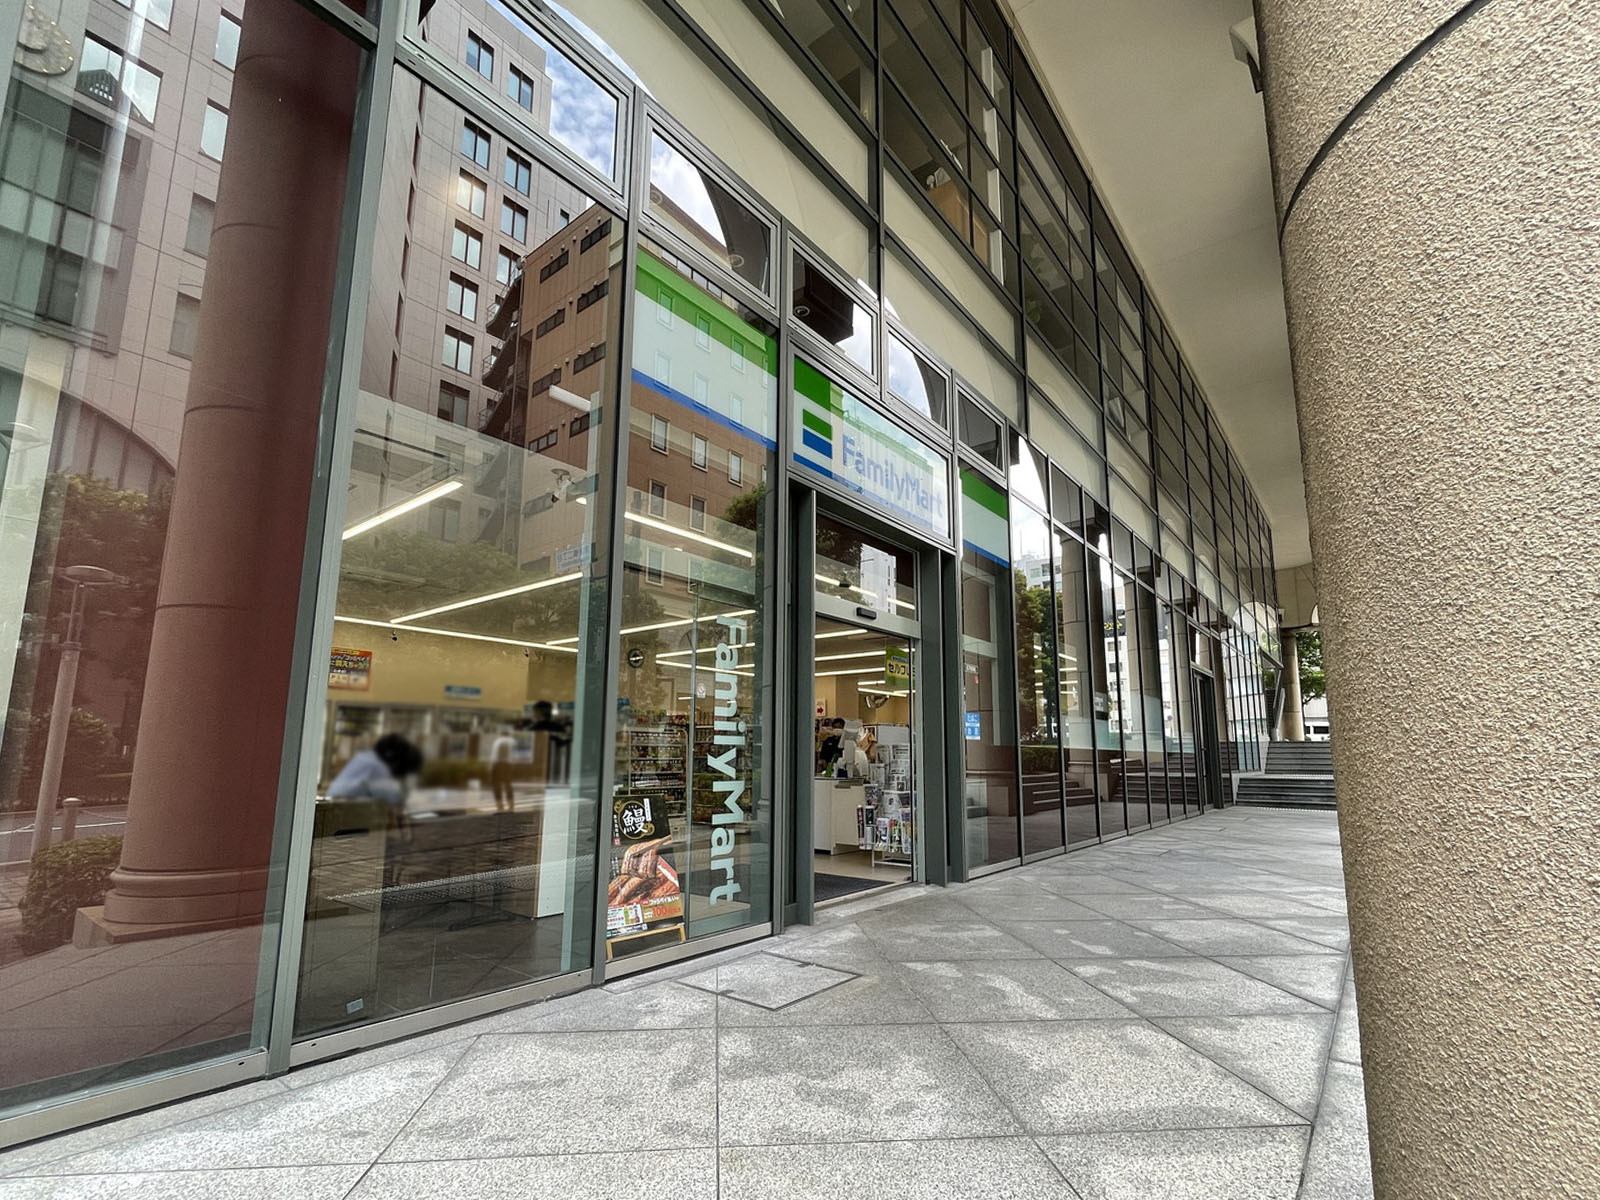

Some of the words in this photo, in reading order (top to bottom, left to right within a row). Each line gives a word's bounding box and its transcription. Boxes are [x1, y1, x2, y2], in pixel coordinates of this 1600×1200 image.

[842, 434, 943, 518] FamilyMart
[708, 615, 748, 906] FamilyMart
[622, 808, 648, 834] 鰻
